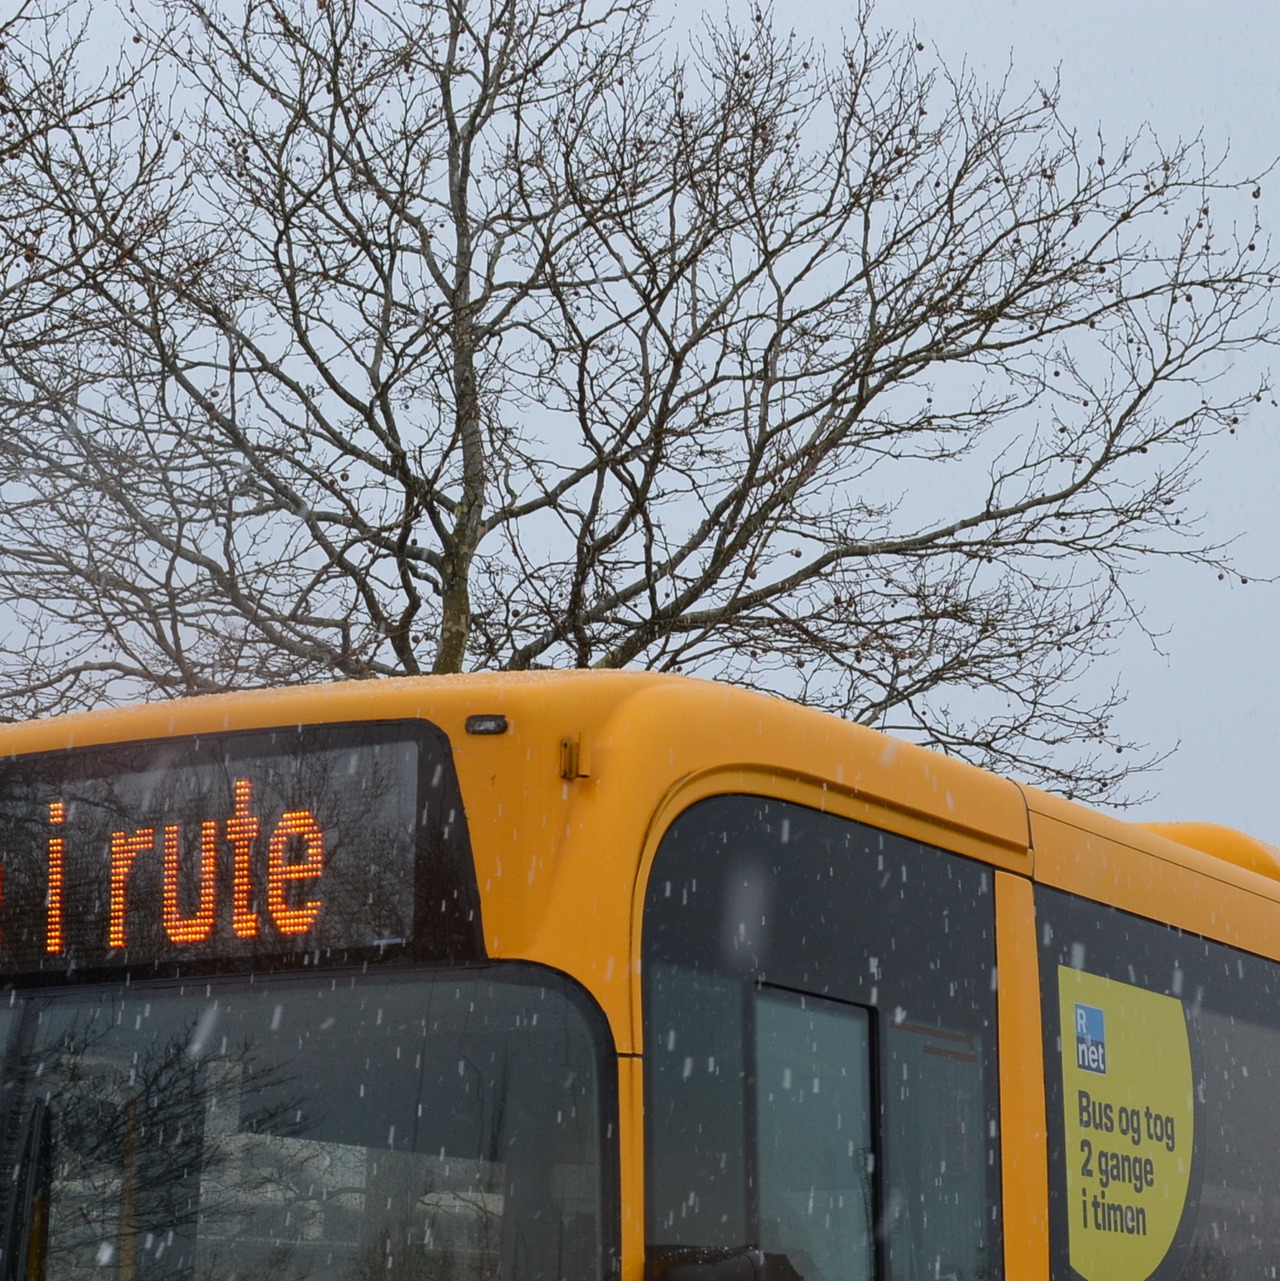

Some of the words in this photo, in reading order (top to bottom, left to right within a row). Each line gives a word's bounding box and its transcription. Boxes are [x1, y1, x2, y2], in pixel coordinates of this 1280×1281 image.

[46, 801, 64, 954] i
[108, 779, 323, 949] rute
[1076, 1008, 1087, 1033] R
[1078, 1040, 1105, 1070] net
[1077, 1090, 1114, 1133] Bus
[1118, 1106, 1141, 1145] og
[1144, 1105, 1175, 1152] tog
[1080, 1139, 1093, 1177] 2
[1098, 1149, 1154, 1193] gange
[1082, 1188, 1088, 1229] i
[1092, 1191, 1147, 1236] timen
